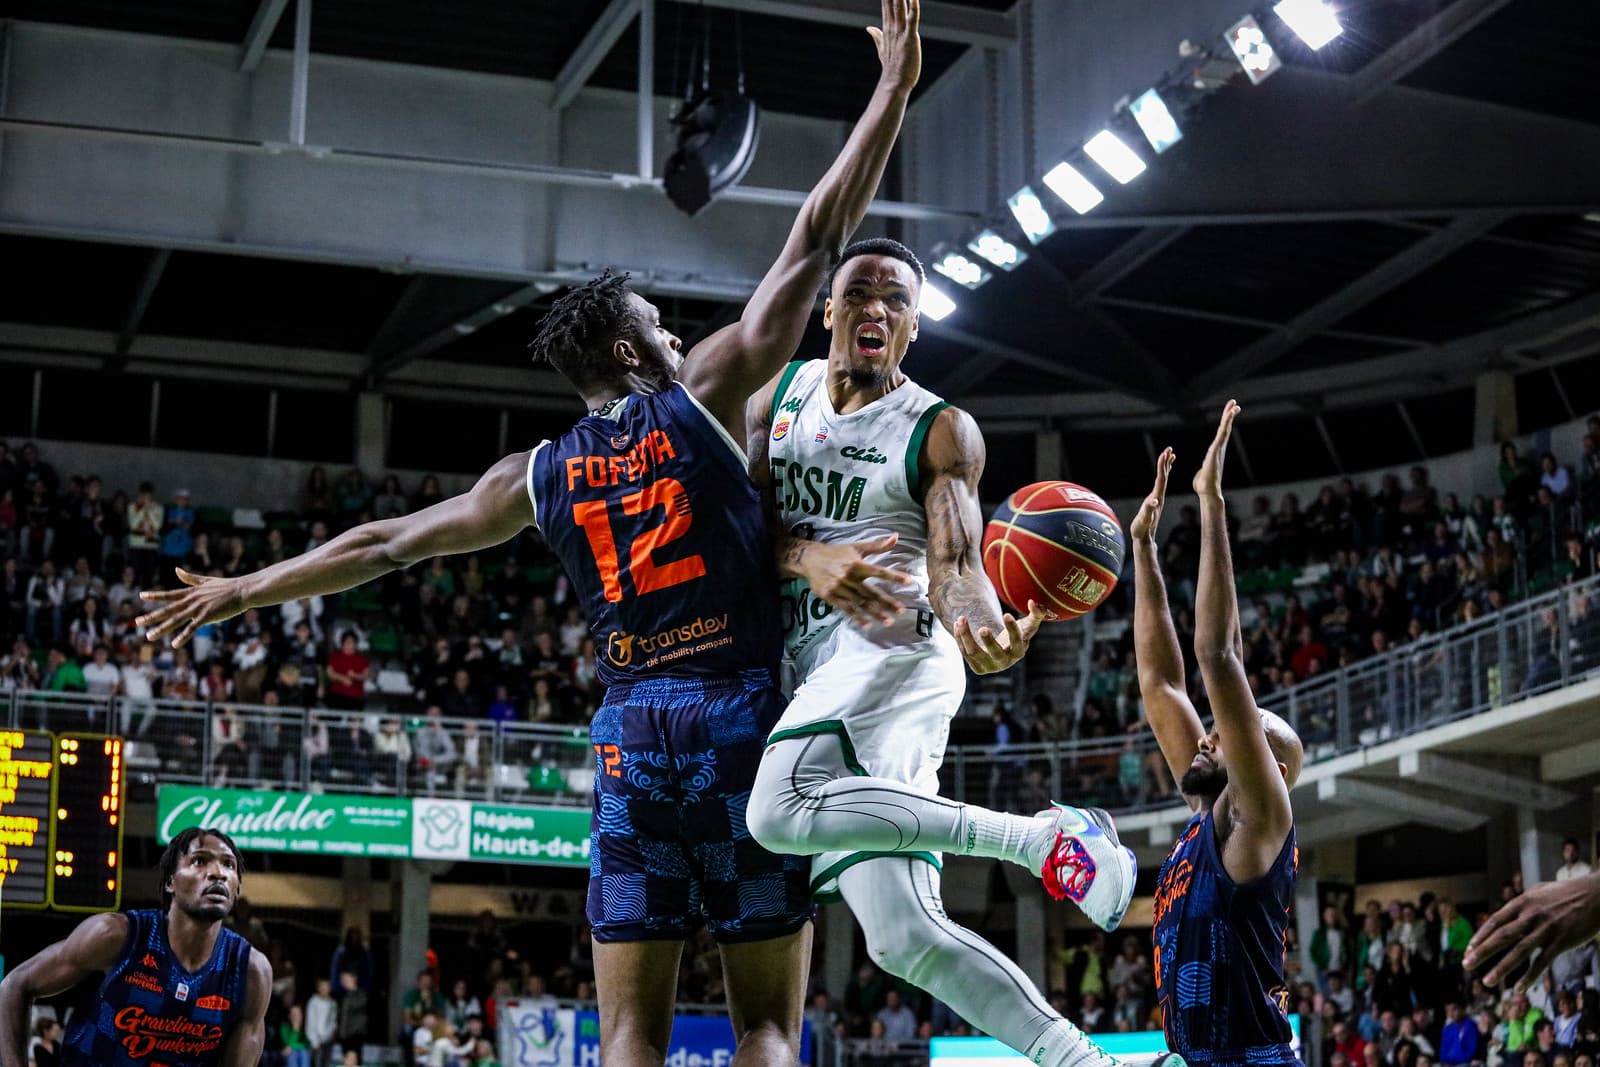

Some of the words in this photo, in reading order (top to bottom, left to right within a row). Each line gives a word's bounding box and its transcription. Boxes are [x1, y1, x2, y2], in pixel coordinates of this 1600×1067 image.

[771, 457, 867, 522] ESSM
[572, 477, 707, 603] 12
[637, 613, 728, 653] transdev
[646, 657, 659, 668] the
[660, 647, 694, 662] mobility
[695, 635, 733, 652] company
[160, 795, 337, 844] Claudelec
[473, 810, 535, 831] Région
